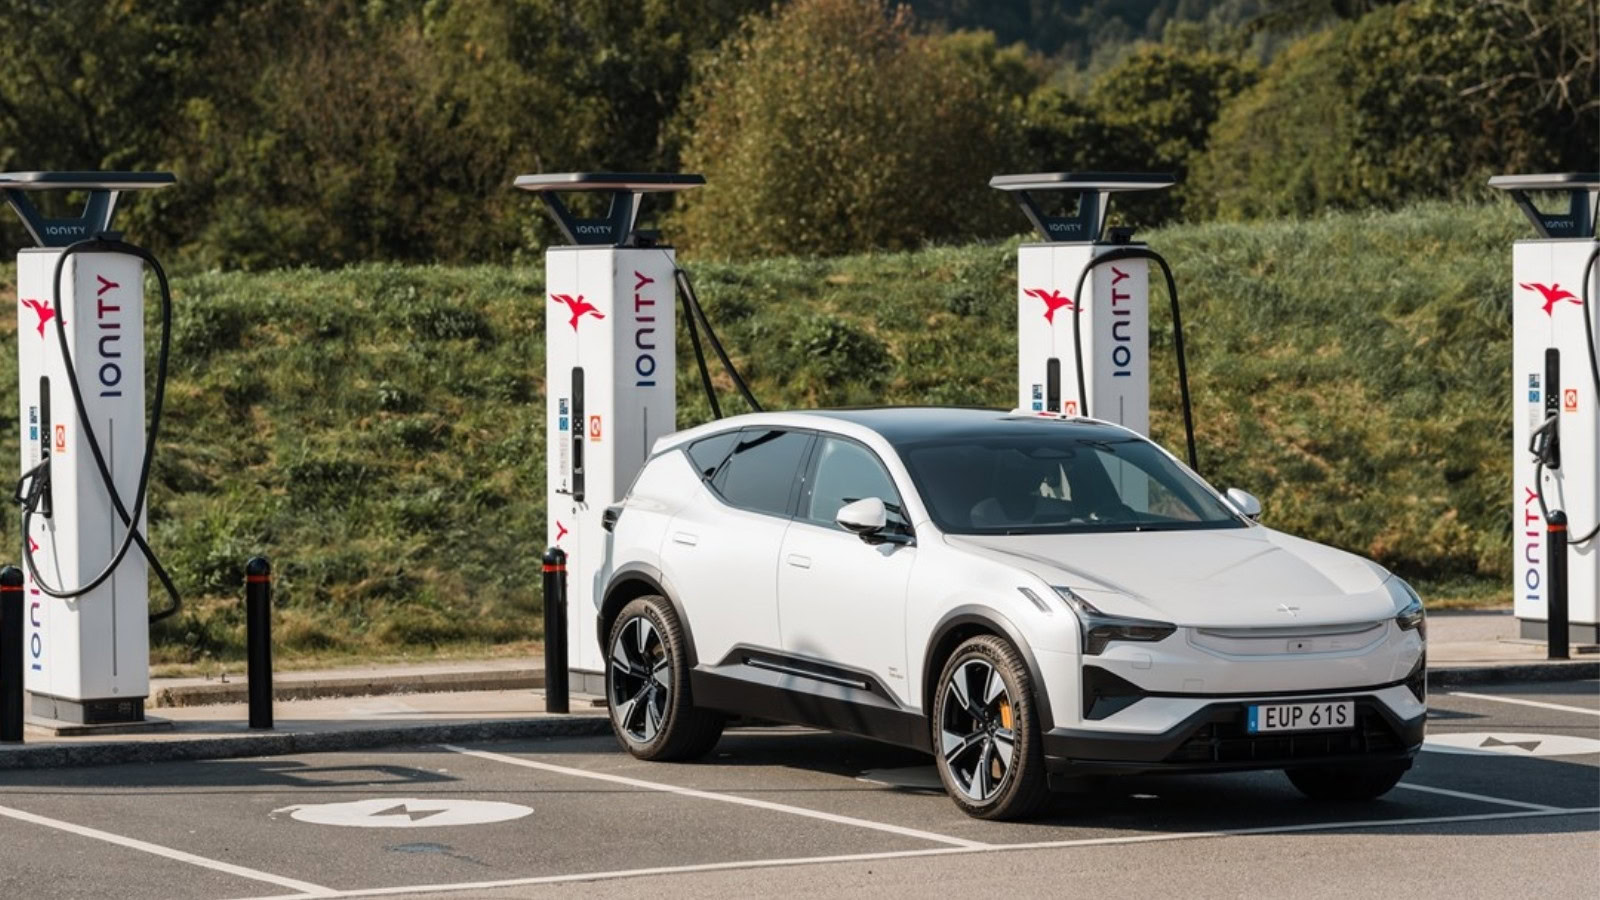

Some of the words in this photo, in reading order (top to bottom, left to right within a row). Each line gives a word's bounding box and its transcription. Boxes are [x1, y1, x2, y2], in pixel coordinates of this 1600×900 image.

[46, 226, 86, 235] IONITY
[576, 226, 612, 234] IONITY
[97, 275, 122, 397] IONITY
[634, 270, 656, 387] IONITY
[1112, 266, 1131, 377] IONITY
[1525, 487, 1540, 600] IONITY
[1266, 706, 1303, 728] EUP
[1309, 704, 1346, 726] 61S
